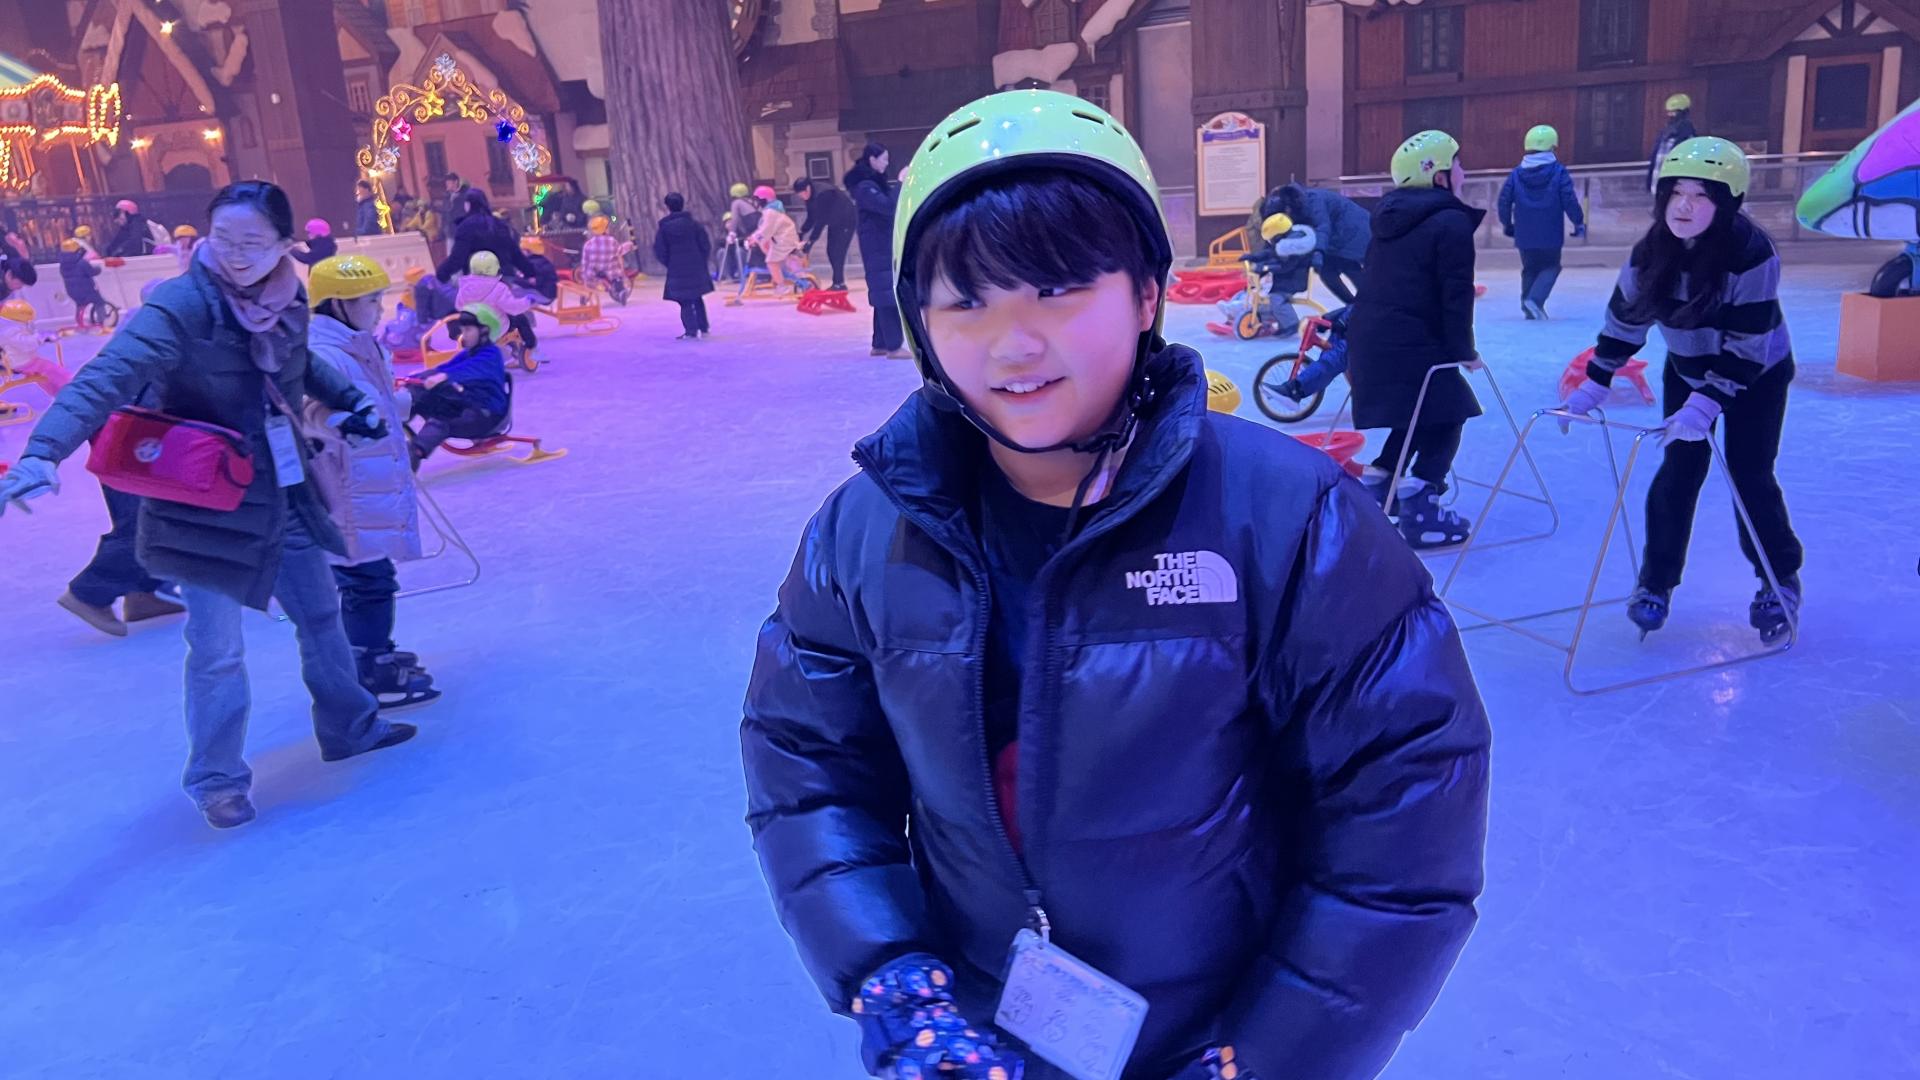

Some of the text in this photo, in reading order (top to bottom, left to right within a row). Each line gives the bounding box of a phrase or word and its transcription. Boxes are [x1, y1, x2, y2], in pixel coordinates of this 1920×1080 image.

[1153, 551, 1196, 570] THE
[1125, 568, 1198, 589] NORTH
[1146, 585, 1200, 606] FACE
